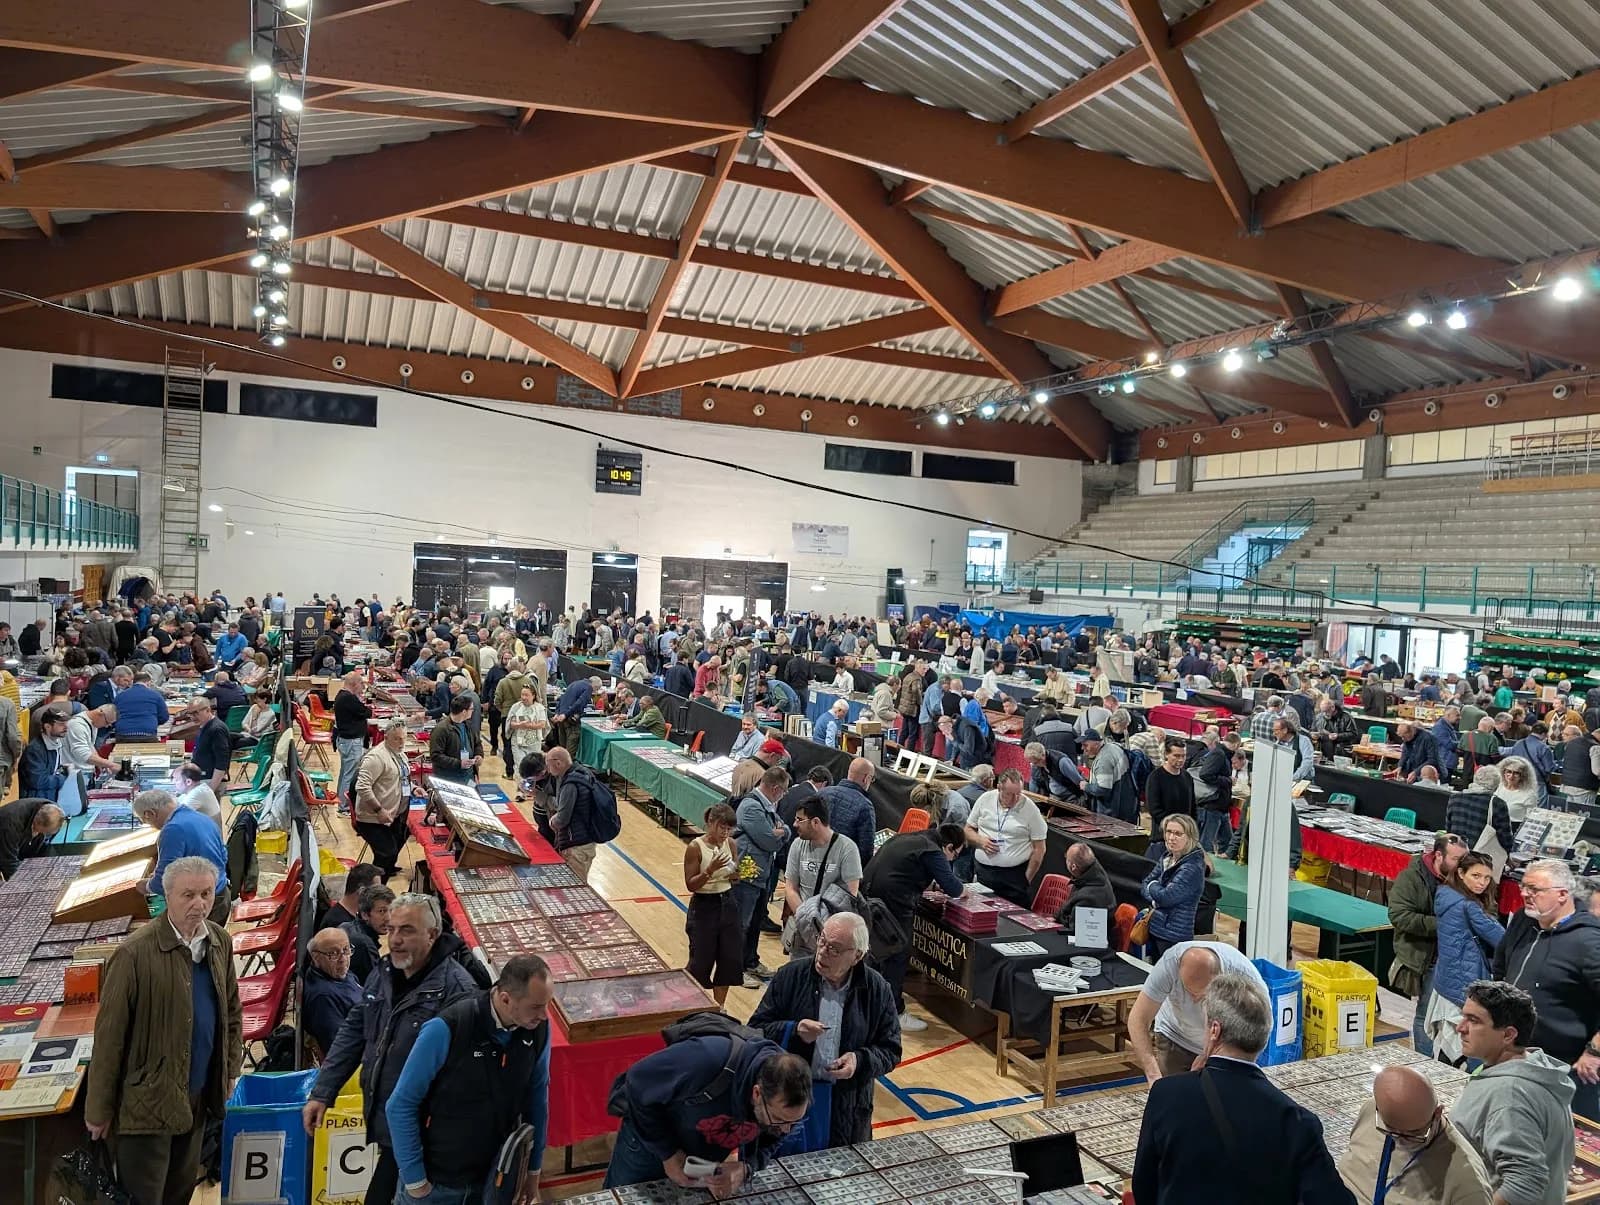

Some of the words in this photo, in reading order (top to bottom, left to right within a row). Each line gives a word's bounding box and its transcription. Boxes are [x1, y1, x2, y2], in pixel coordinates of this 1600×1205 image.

[912, 931, 955, 971] FELSINEA
[1335, 994, 1371, 1002] PLASTICA
[1282, 1007, 1293, 1028] D
[1346, 1012, 1359, 1033] E
[244, 1151, 269, 1181] B
[339, 1145, 366, 1175] C
